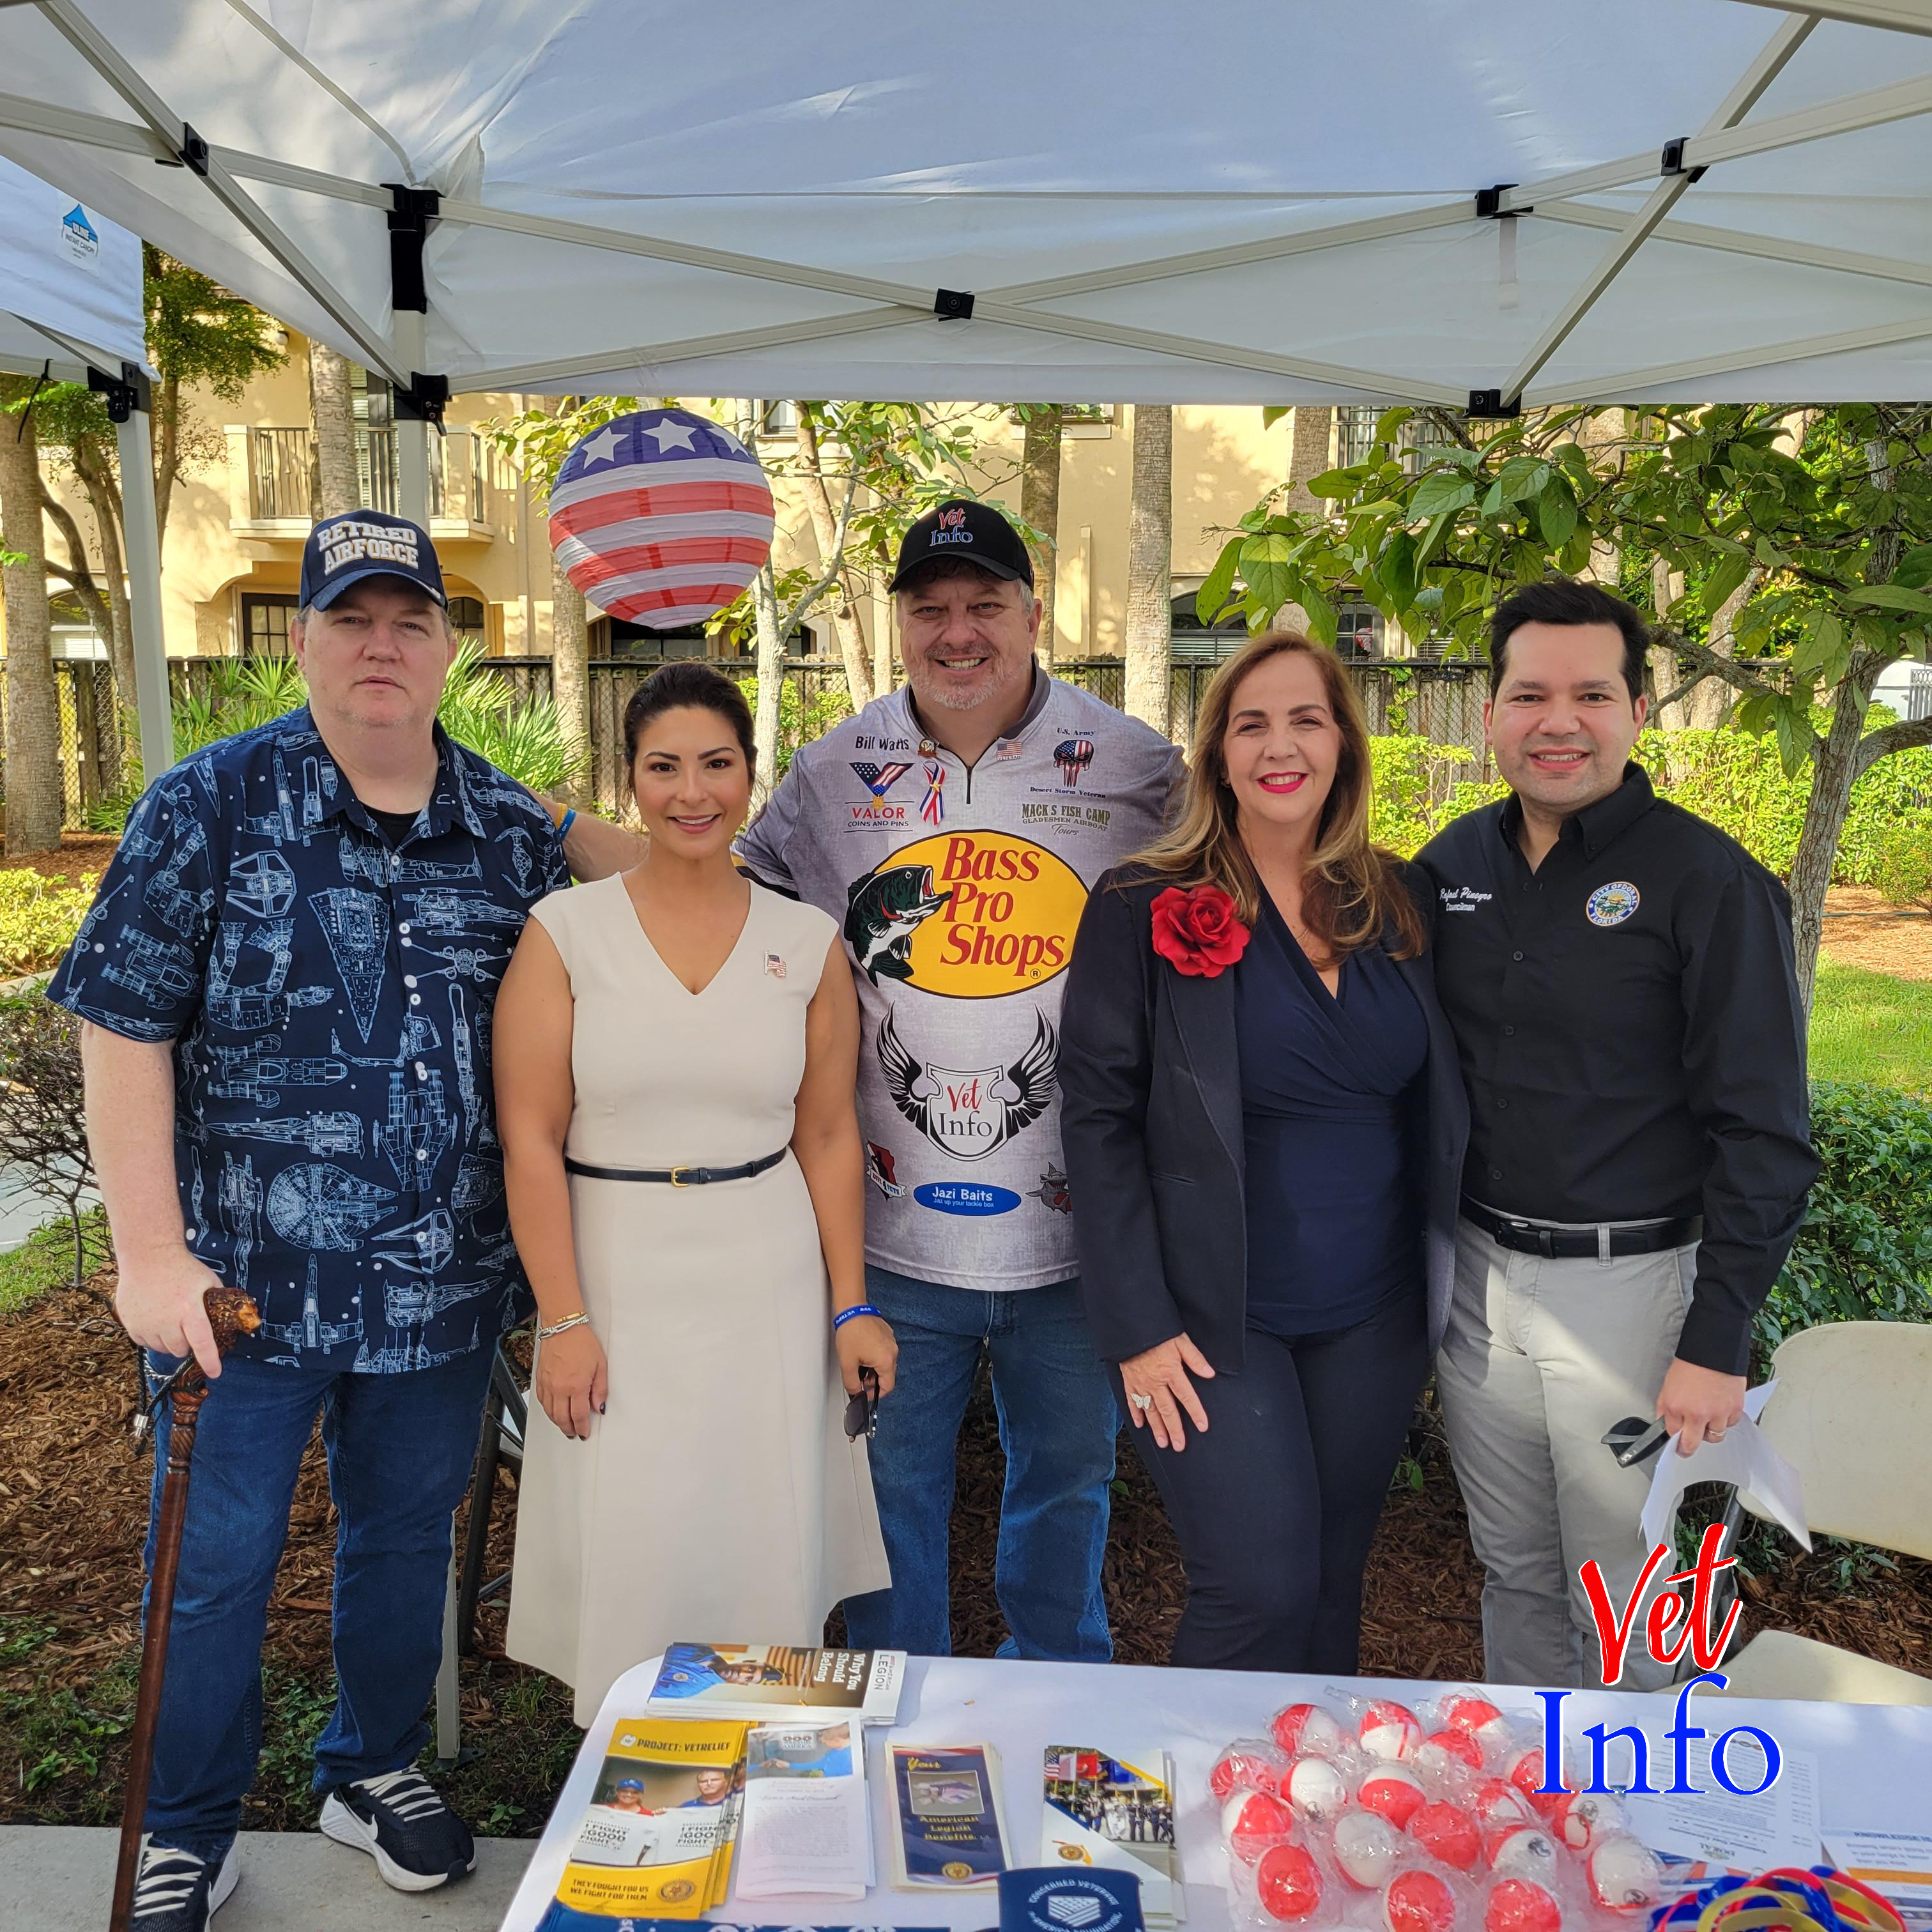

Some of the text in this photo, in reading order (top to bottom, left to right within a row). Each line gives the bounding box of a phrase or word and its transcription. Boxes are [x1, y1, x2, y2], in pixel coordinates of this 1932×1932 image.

[939, 507, 967, 530] Vet
[317, 521, 417, 552] RETIRED
[929, 524, 973, 547] Info
[1057, 727, 1071, 735] U.S.
[855, 736, 909, 751] Bill Watts
[1078, 790, 1106, 799] Veteran
[852, 807, 905, 819] VALOR
[1061, 805, 1082, 818] FISH
[1086, 808, 1110, 825] CAMP
[1052, 823, 1080, 836] Tours
[1073, 818, 1108, 832] AIRBOAT
[939, 838, 1041, 882] Bass
[941, 882, 1014, 923] Pro
[1592, 885, 1609, 901] CITY
[1622, 884, 1637, 905] DORAL
[1590, 912, 1623, 924] FLORIDA
[940, 923, 1066, 976] Shops
[947, 1078, 982, 1112] Vet
[938, 1110, 992, 1137] Info
[932, 1186, 992, 1201] Jazi Baits
[814, 1651, 834, 1682] Belong
[832, 1652, 850, 1683] Should
[847, 1653, 866, 1690] Why You
[874, 1654, 889, 1690] LEGION
[637, 1738, 730, 1751] PROJECT: VETRELIEF
[588, 1830, 625, 1842] GOOD
[593, 1825, 629, 1835] FIGHT
[580, 1835, 611, 1844] FIGHT
[573, 1879, 592, 1887] THEY
[593, 1882, 621, 1891] FOUGHT
[583, 1889, 606, 1897] FIGHT
